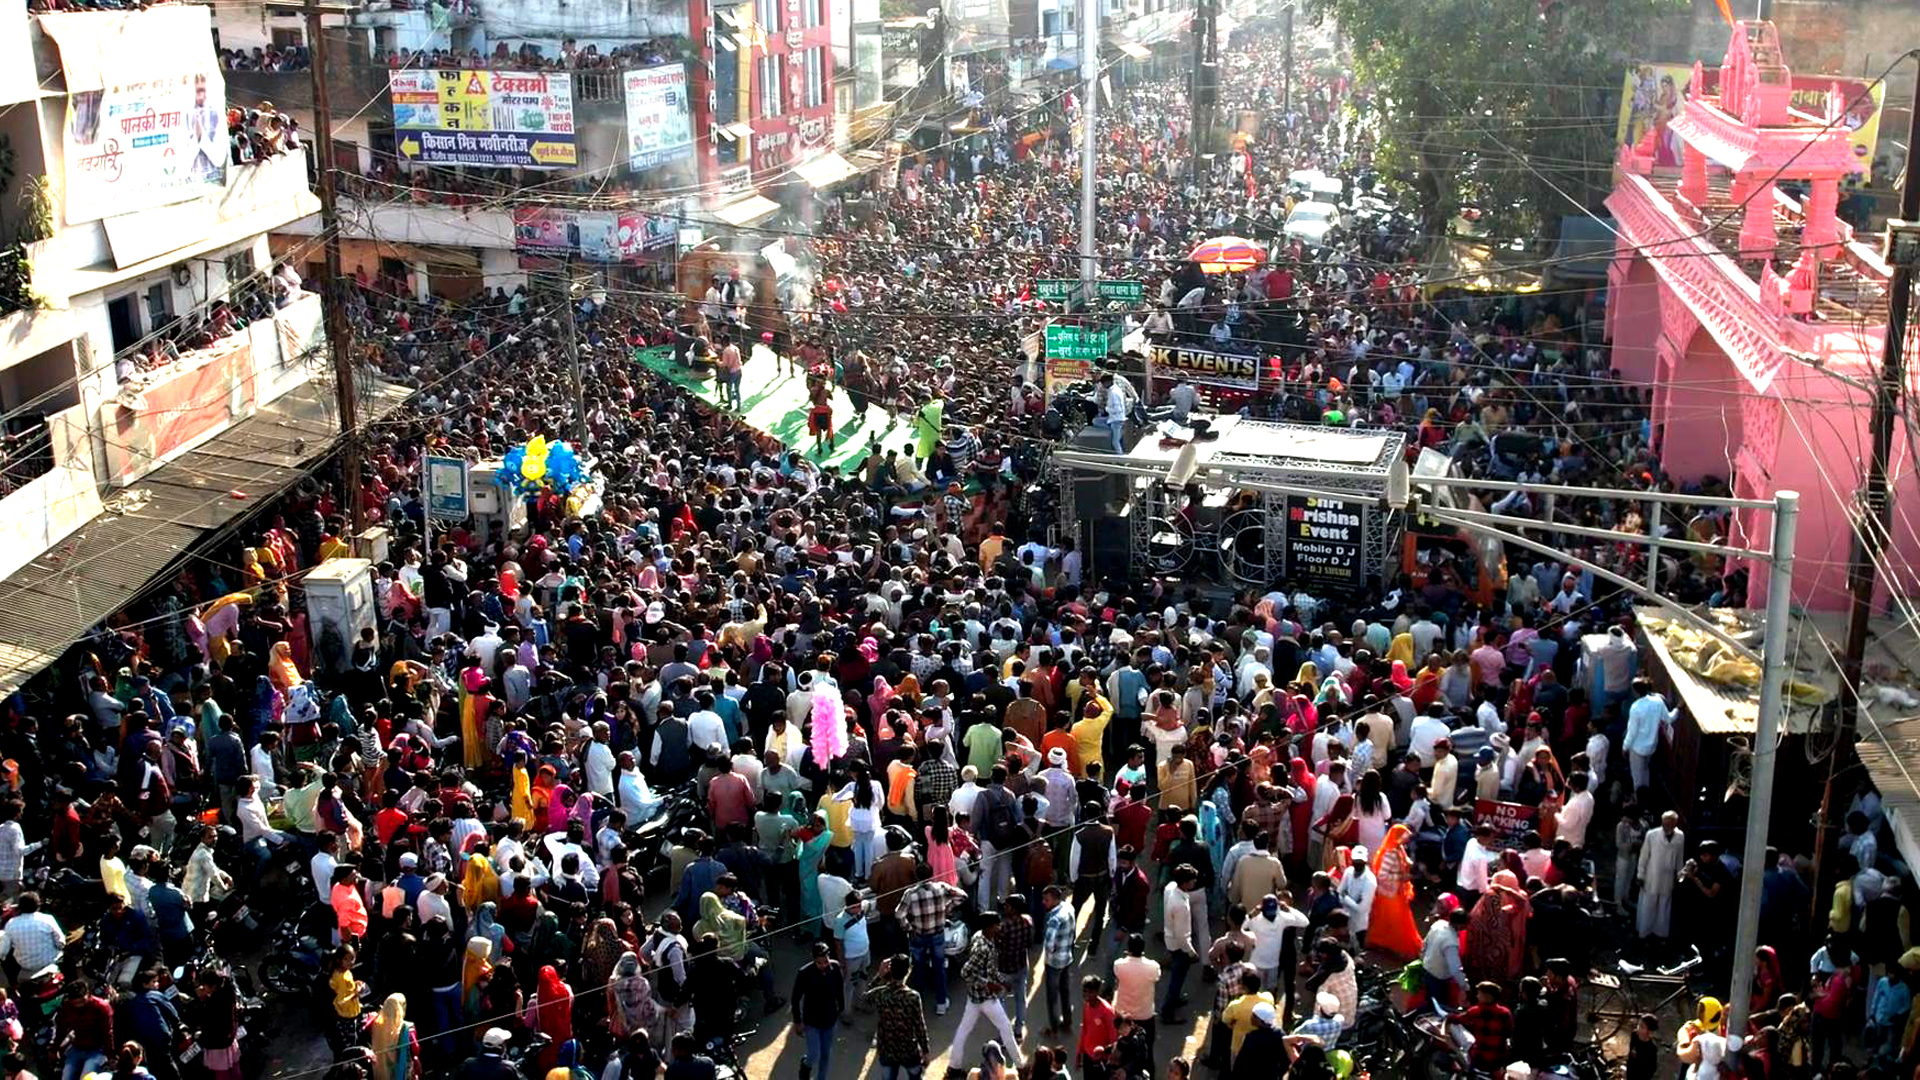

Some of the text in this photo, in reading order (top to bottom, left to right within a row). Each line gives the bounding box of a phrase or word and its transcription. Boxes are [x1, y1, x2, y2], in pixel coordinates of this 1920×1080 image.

[491, 71, 548, 93] टेक्समो
[120, 107, 156, 135] पालकी
[159, 111, 181, 129] यात्रा
[421, 131, 528, 152] किसान मित्र मशीनरीज
[1177, 351, 1254, 375] EVENTS
[1300, 523, 1349, 540] Event
[1293, 542, 1332, 554] Mobile
[1297, 553, 1328, 564] Floor
[1496, 805, 1517, 817] NO
[1477, 813, 1530, 830] PARKING
